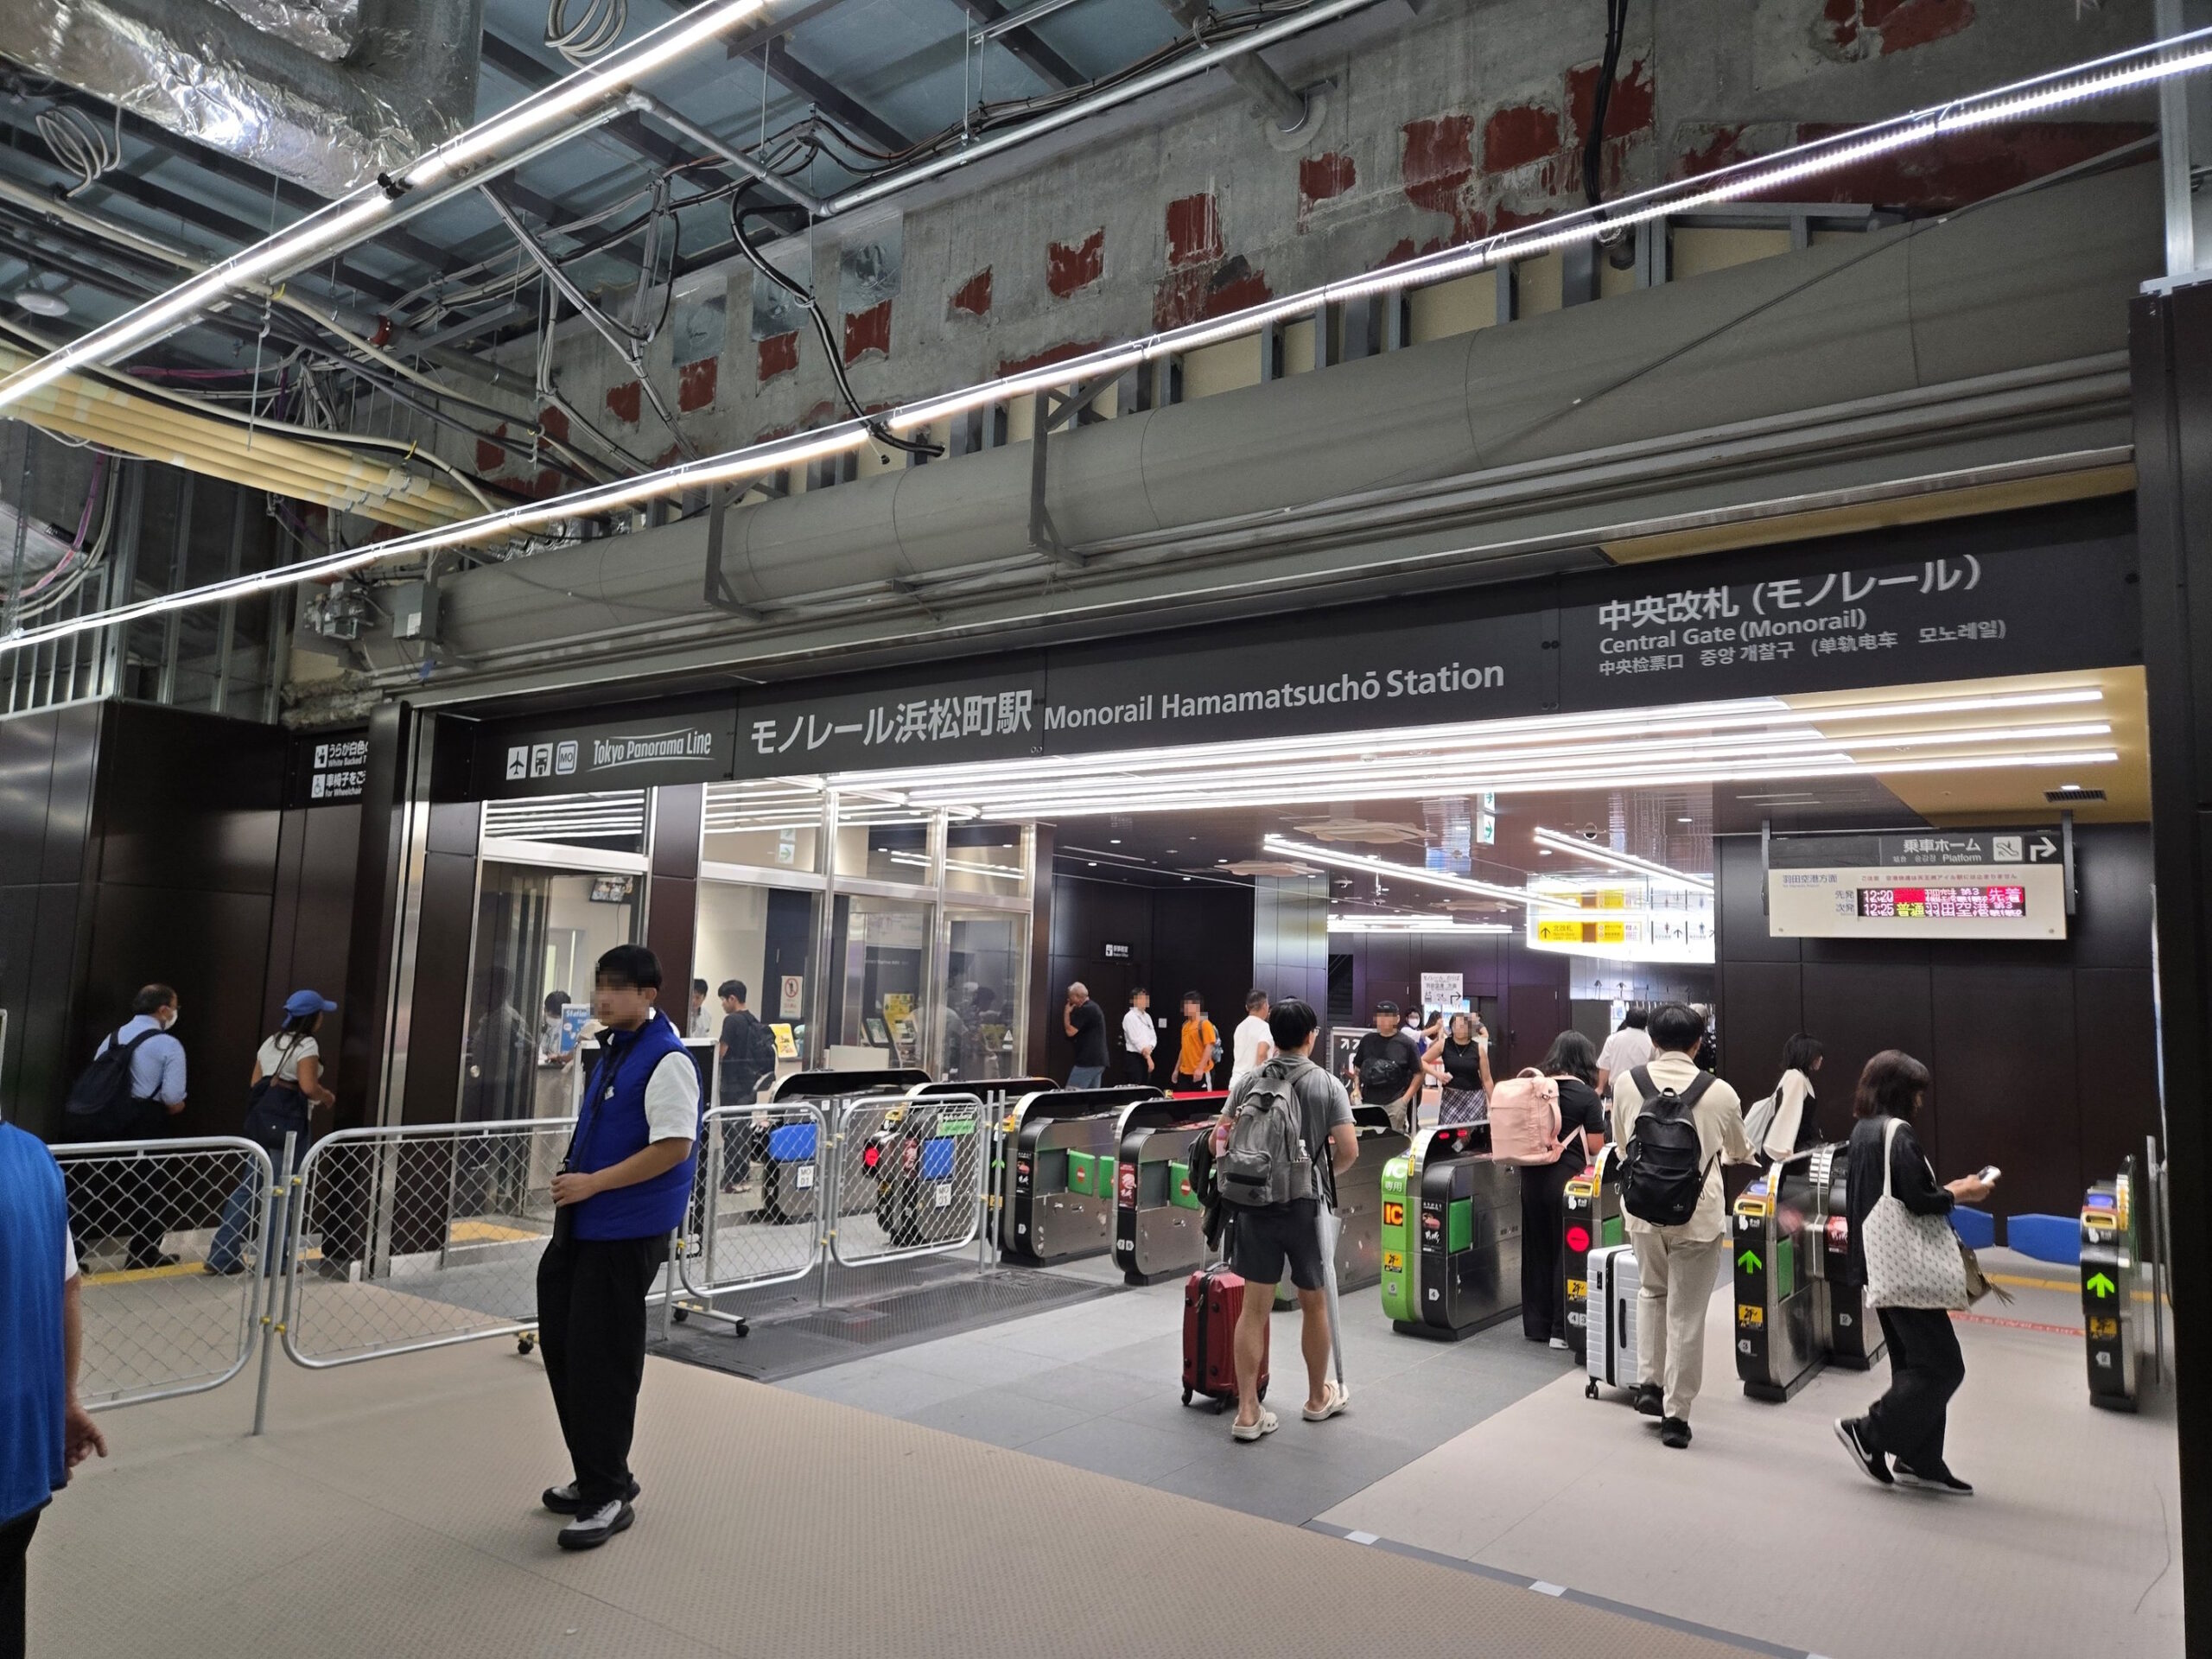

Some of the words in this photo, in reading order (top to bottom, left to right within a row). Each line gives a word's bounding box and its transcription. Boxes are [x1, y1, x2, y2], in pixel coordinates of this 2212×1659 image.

[1599, 630, 1676, 654] Central
[1683, 626, 1736, 645] Gate
[1740, 608, 1867, 642] (Monorail)
[1599, 654, 1684, 676] 中央检票口
[1700, 646, 1736, 666] 중앙
[751, 690, 1033, 754] モノレール浜松町駅
[1045, 696, 1153, 729] Monorail
[1162, 671, 1381, 719] Hamamatsuchō
[1387, 662, 1504, 696] Station
[594, 740, 624, 766] Tokyo
[626, 737, 684, 759] Panorama
[687, 732, 712, 755] Line
[1903, 838, 1981, 853] 乗車ホーム
[1942, 854, 1982, 862] Platform
[1864, 889, 1893, 903] 12:20
[1864, 903, 1894, 917] 12:25
[1897, 903, 1924, 917] 普通
[1925, 903, 1989, 917] 羽田空港
[1385, 1205, 1403, 1225] IC
